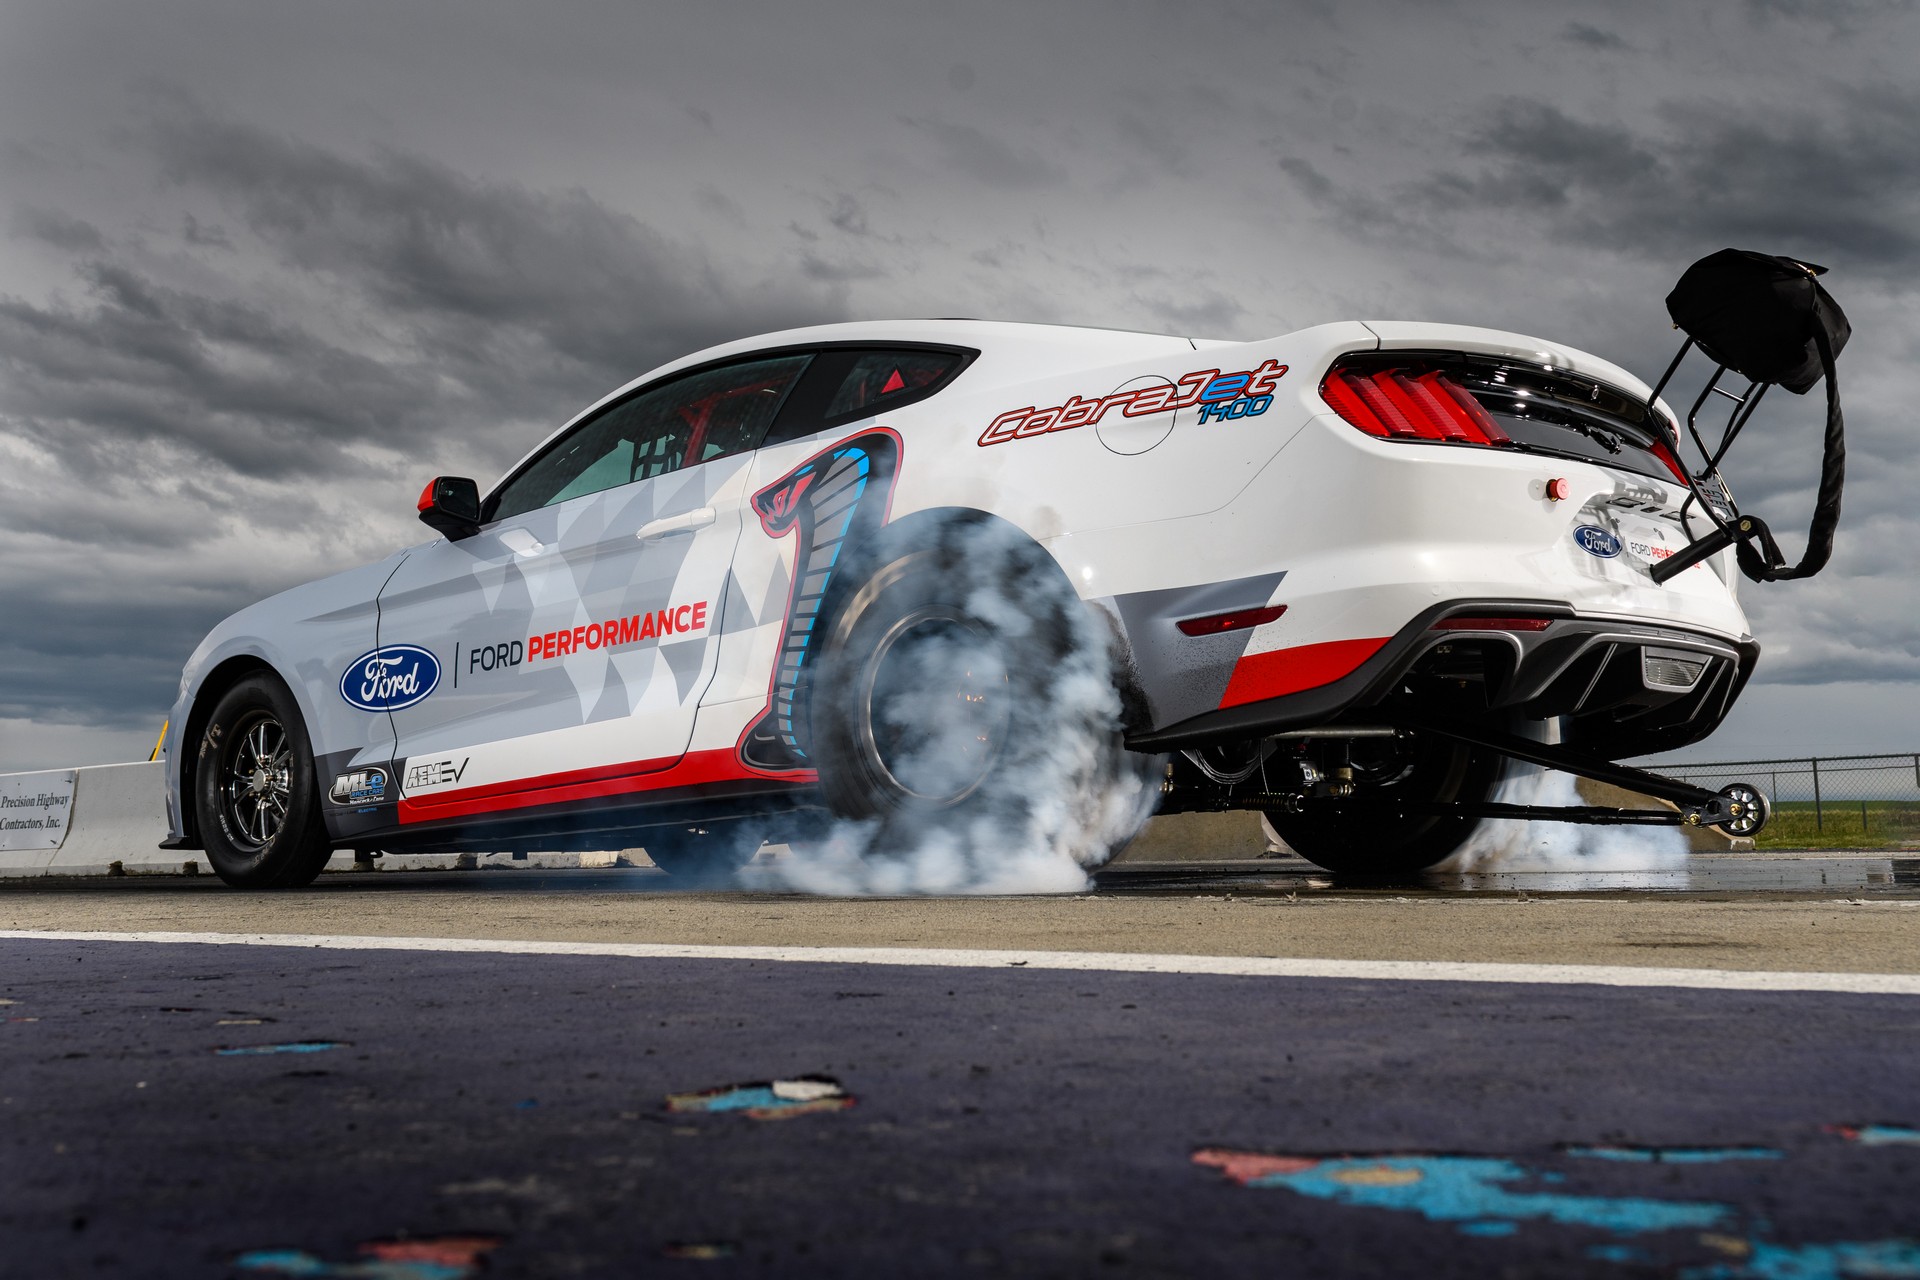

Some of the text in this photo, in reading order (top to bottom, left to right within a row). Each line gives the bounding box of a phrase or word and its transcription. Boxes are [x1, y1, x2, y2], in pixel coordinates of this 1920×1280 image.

[1197, 394, 1274, 425] 1400
[1584, 529, 1613, 552] Ford
[1630, 542, 1651, 556] FORD
[470, 601, 708, 674] FORD PERFORMANCE
[361, 656, 420, 701] Ford
[1, 792, 70, 810] Precision Highway
[0, 815, 61, 831] Contractors, Inc.
